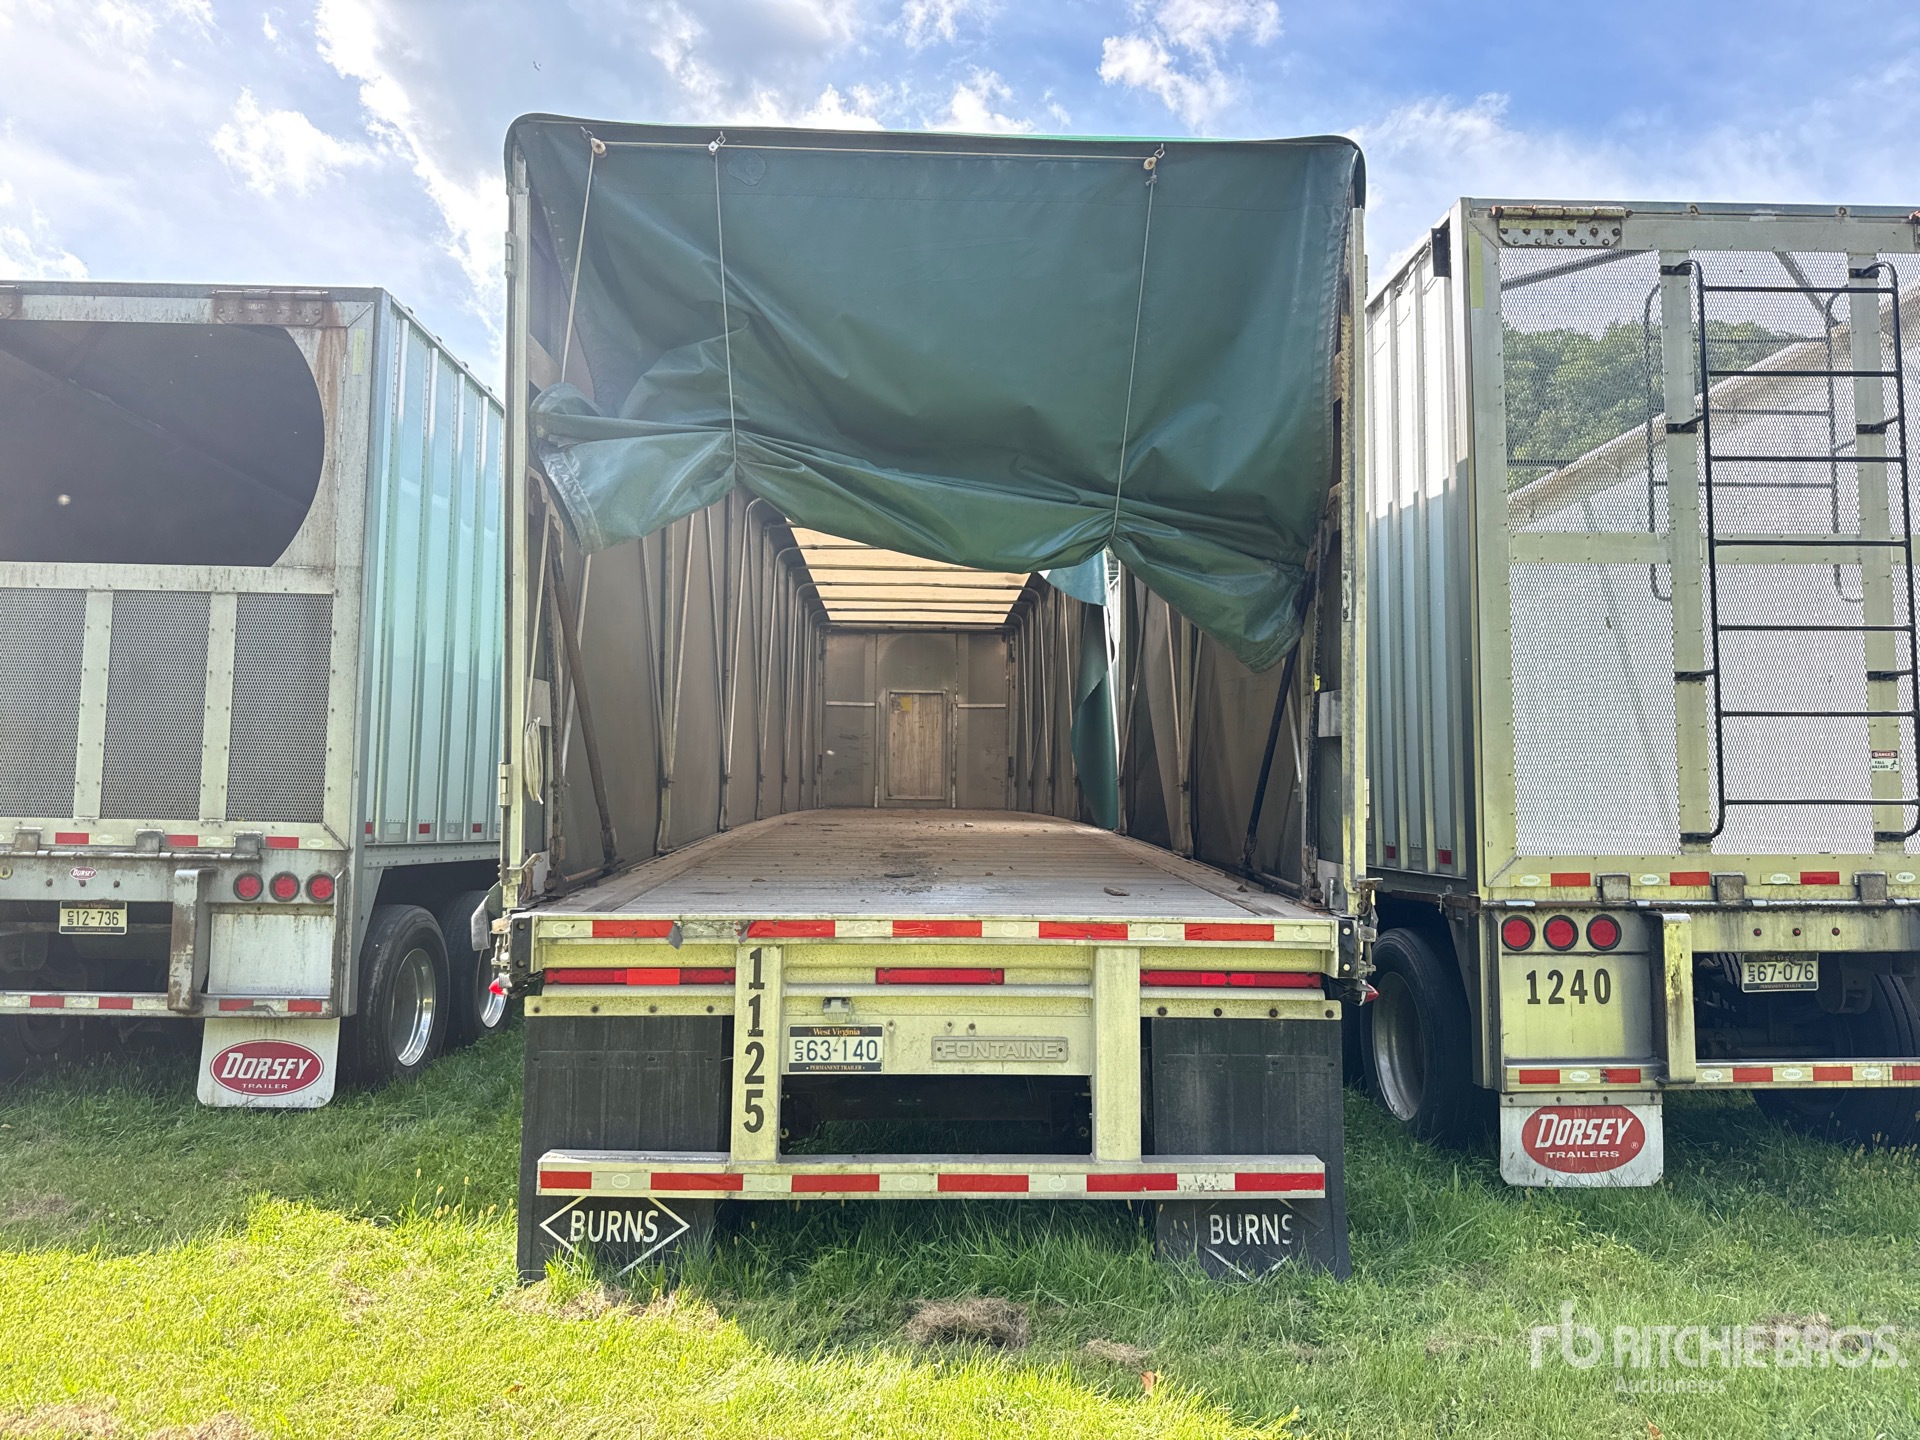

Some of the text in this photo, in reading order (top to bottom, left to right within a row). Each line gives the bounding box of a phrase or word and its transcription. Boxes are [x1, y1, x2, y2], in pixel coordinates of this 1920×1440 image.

[72, 868, 95, 876] DORSEY
[76, 910, 119, 926] 12-736
[1526, 968, 1612, 1005] 1240
[813, 1027, 861, 1036] West Virginia
[806, 1039, 878, 1062] 63-140
[942, 1041, 1059, 1058] FONTAINE
[221, 1052, 313, 1080] DORSEY
[1535, 1113, 1634, 1149] DORSEY
[1547, 1150, 1620, 1159] TRAILERS
[570, 1210, 659, 1243] BURNS
[1209, 1213, 1294, 1245] BURNS
